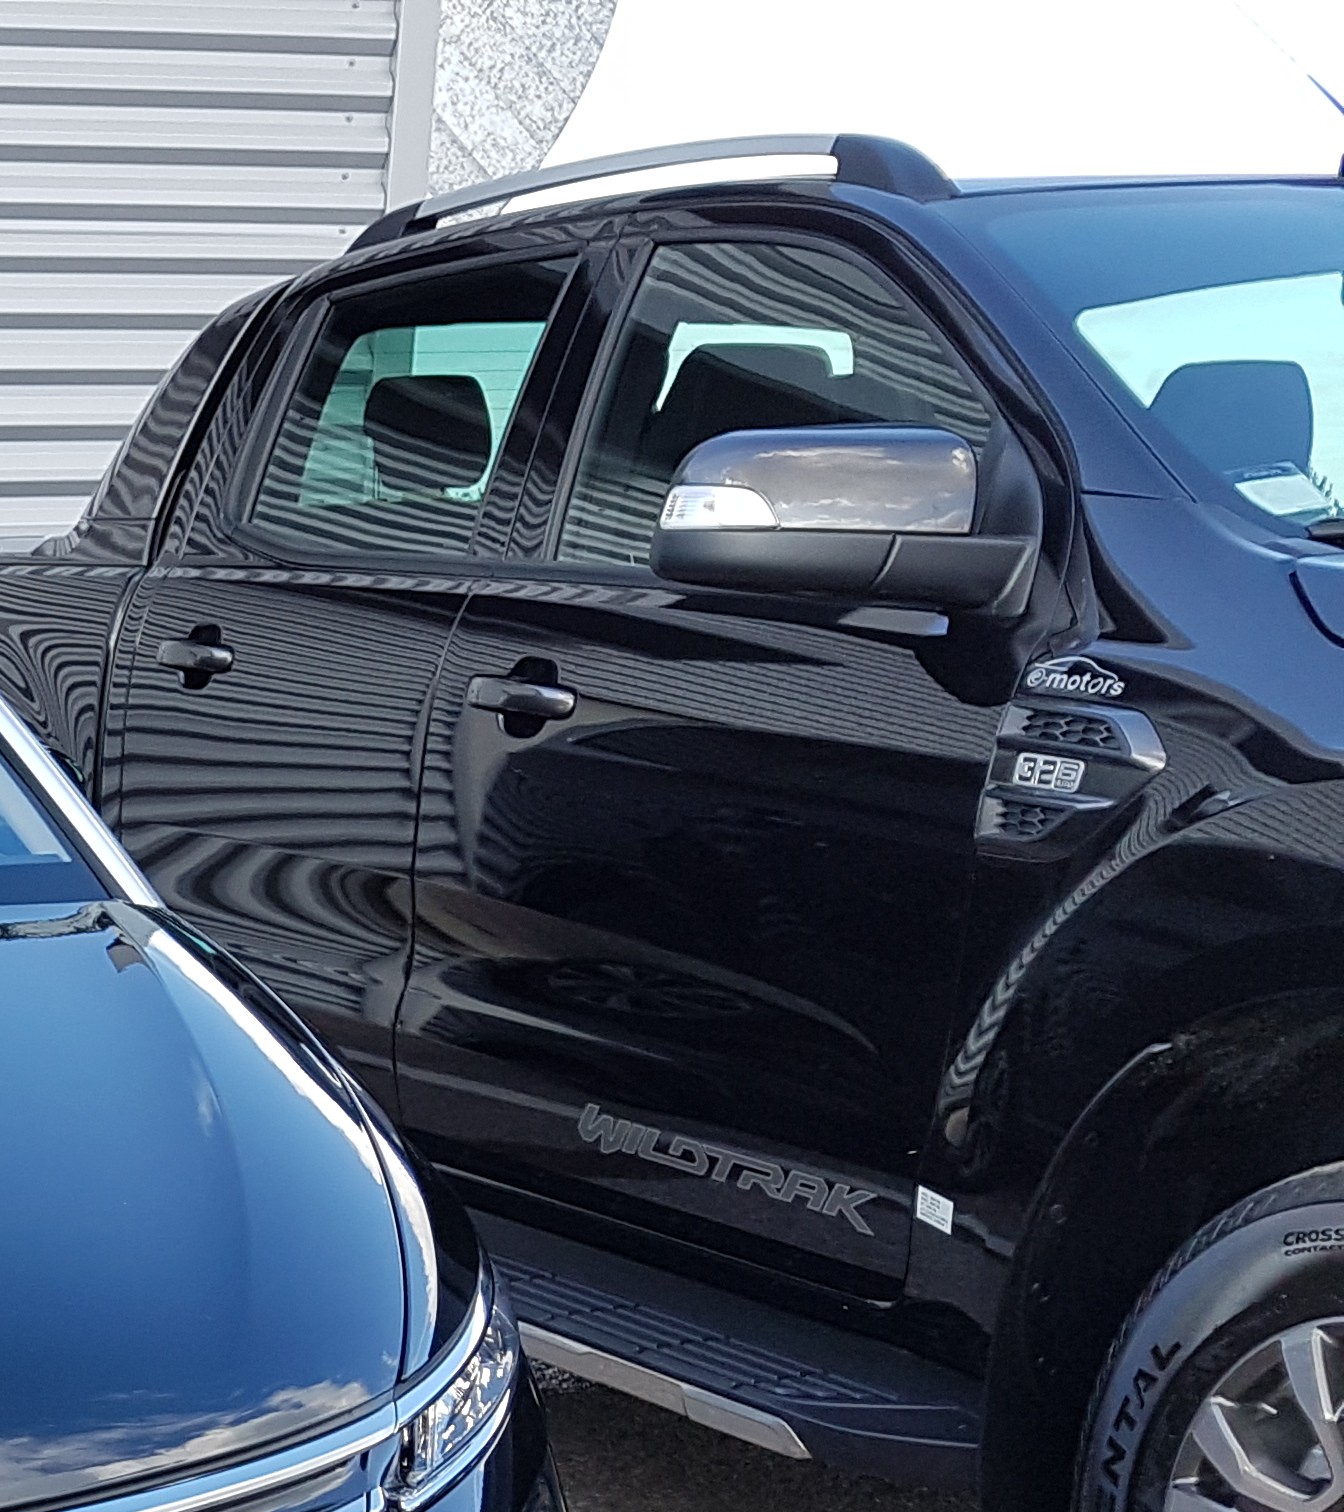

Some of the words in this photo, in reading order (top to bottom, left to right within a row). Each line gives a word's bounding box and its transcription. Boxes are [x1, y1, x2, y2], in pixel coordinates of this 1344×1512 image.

[1027, 667, 1125, 696] e-motors
[577, 1103, 878, 1236] WILDTRAK
[1283, 1228, 1344, 1246] CROSS
